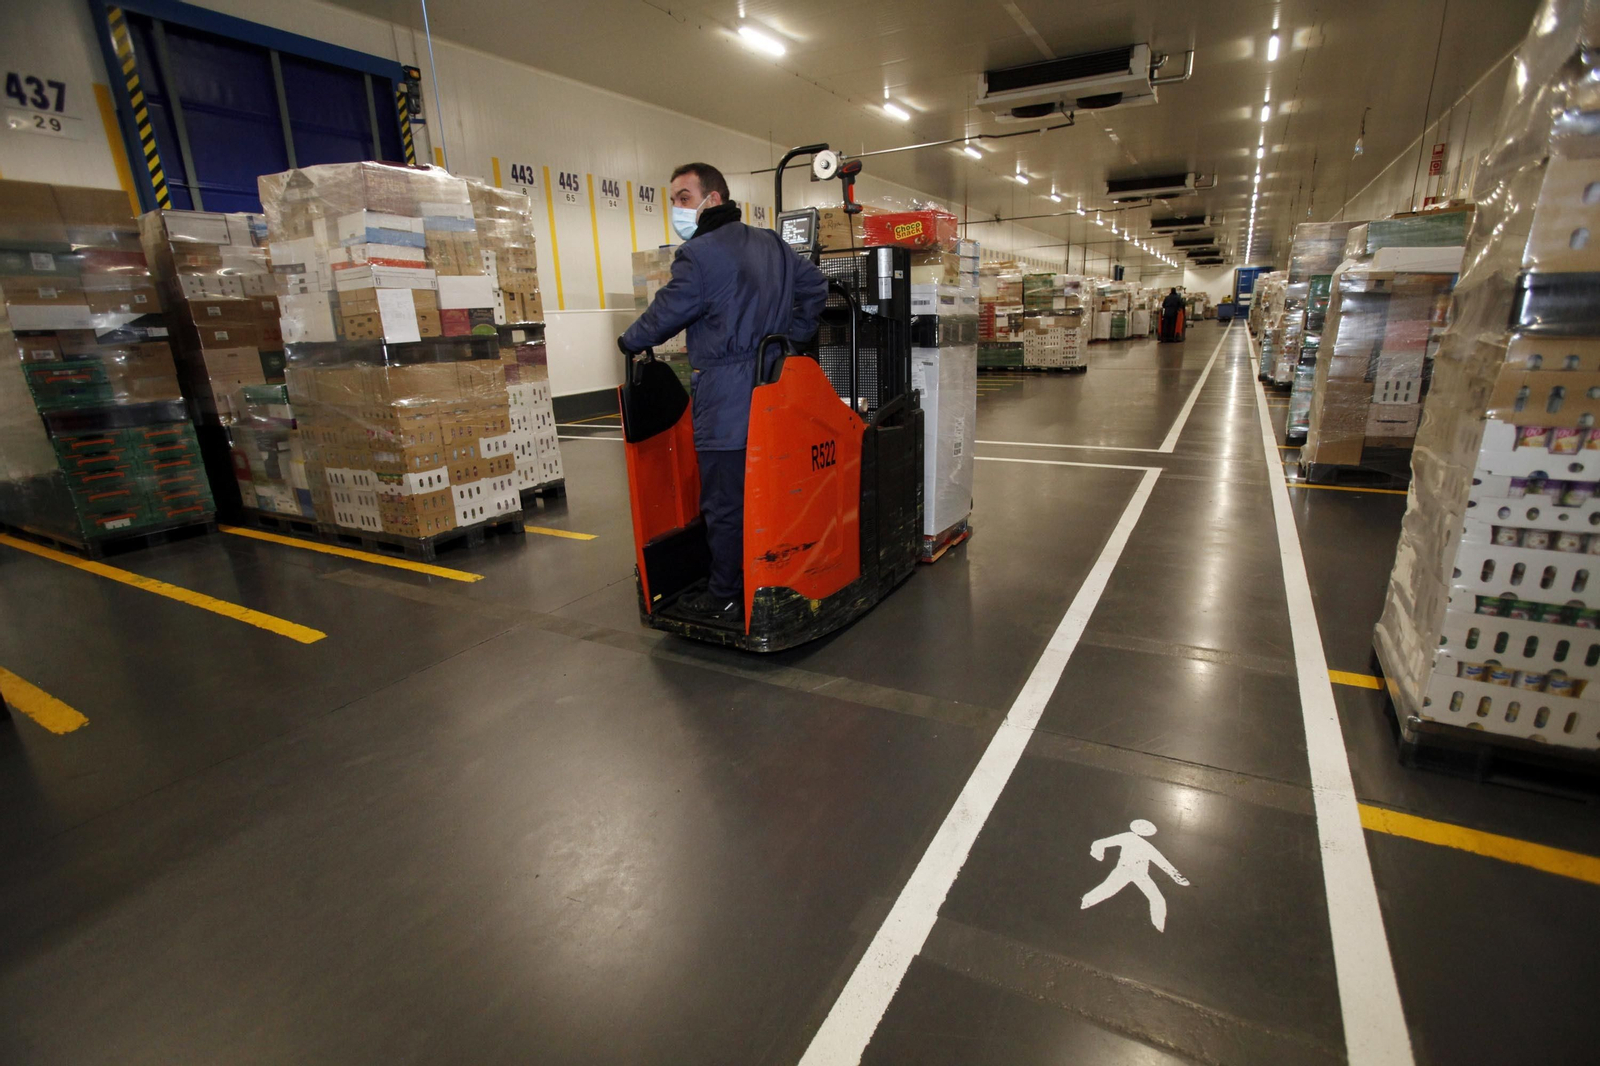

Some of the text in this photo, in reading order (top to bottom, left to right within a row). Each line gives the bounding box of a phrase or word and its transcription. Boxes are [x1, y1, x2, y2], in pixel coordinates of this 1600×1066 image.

[6, 72, 66, 113] 437
[33, 115, 61, 132] 29
[511, 163, 534, 185] 443
[558, 171, 579, 192] 445
[602, 179, 620, 198] 446
[639, 185, 655, 203] 447
[566, 194, 577, 202] 65
[609, 199, 617, 208] 94
[645, 205, 653, 213] 48
[895, 222, 921, 233] Choco
[896, 227, 922, 239] Snack
[811, 440, 836, 471] R522
